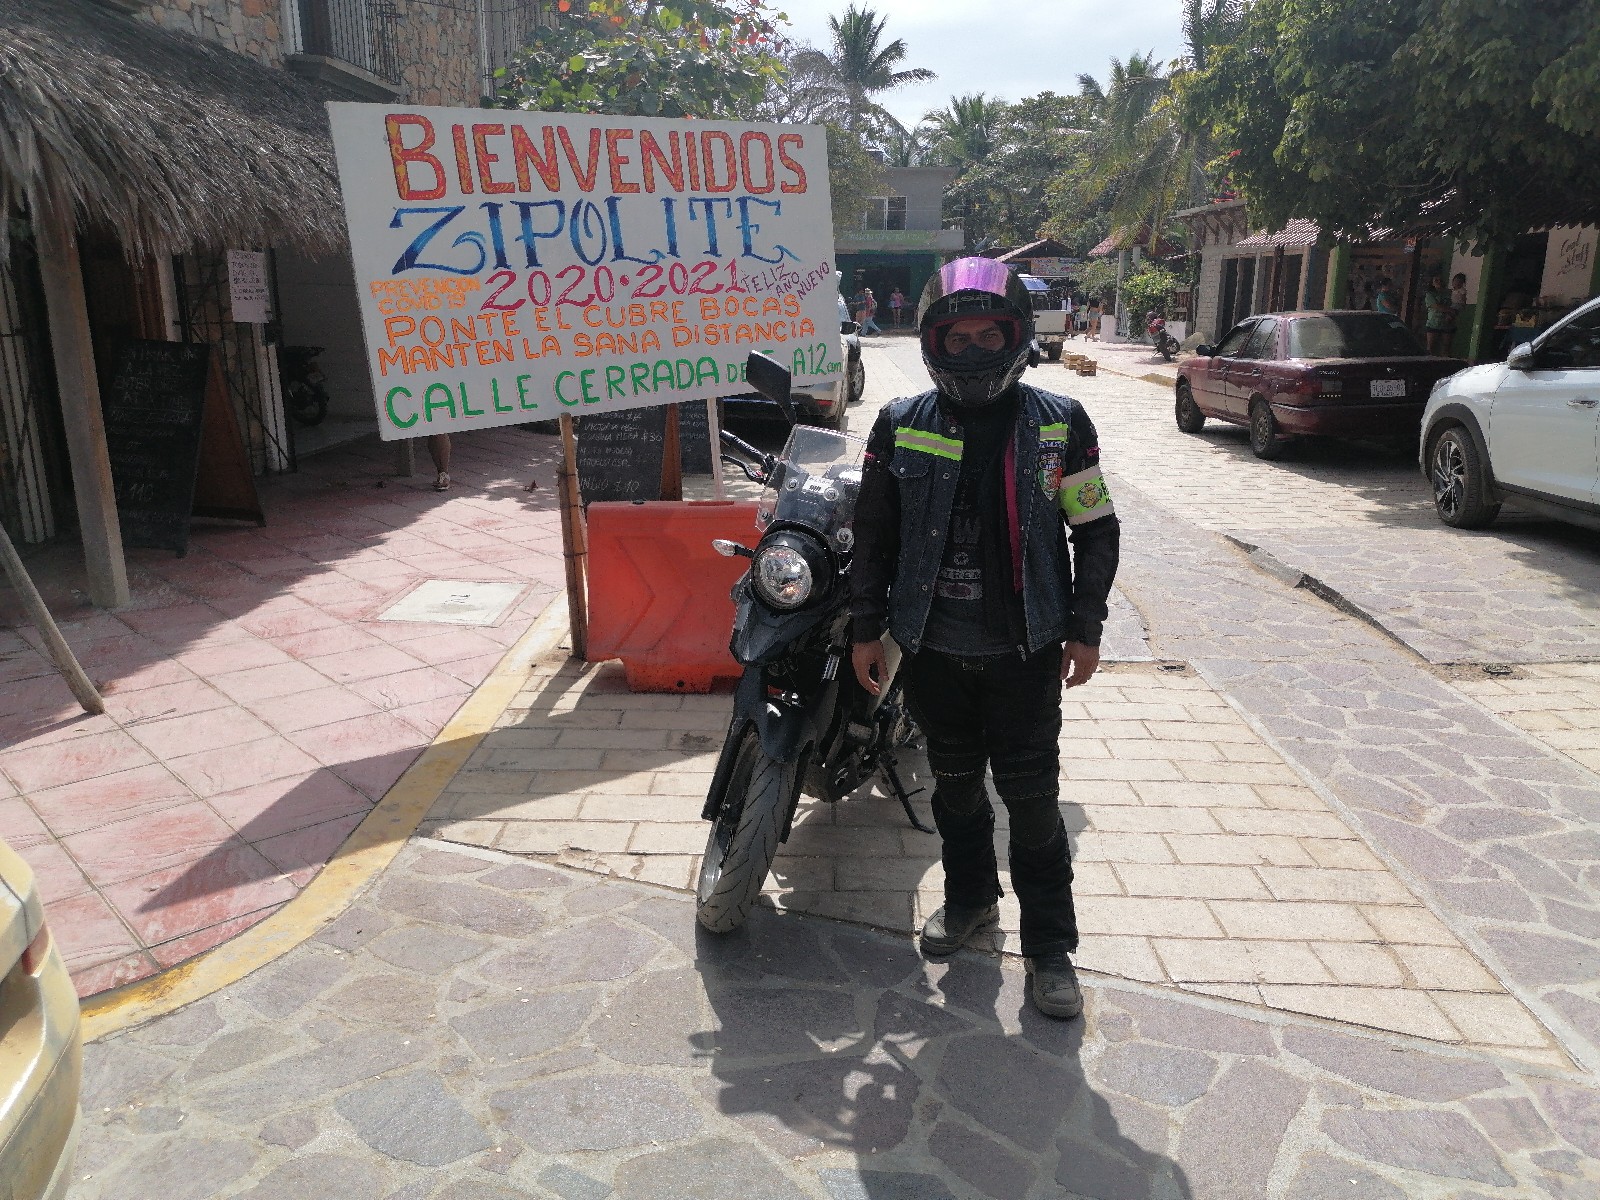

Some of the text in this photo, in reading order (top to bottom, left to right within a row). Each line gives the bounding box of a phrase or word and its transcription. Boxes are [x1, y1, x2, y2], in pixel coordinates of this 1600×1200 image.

[384, 113, 808, 201] BIENVENIDOS
[389, 194, 800, 276] ZIPOLITE
[378, 293, 443, 316] COVID
[796, 261, 830, 301] NUEVO
[376, 317, 816, 377] MANTEN LA SANA DISTANCIA
[383, 293, 802, 348] PONTE EL CUBRE BOCAS
[384, 372, 539, 430] CALLE
[553, 355, 720, 407] CERRADA
